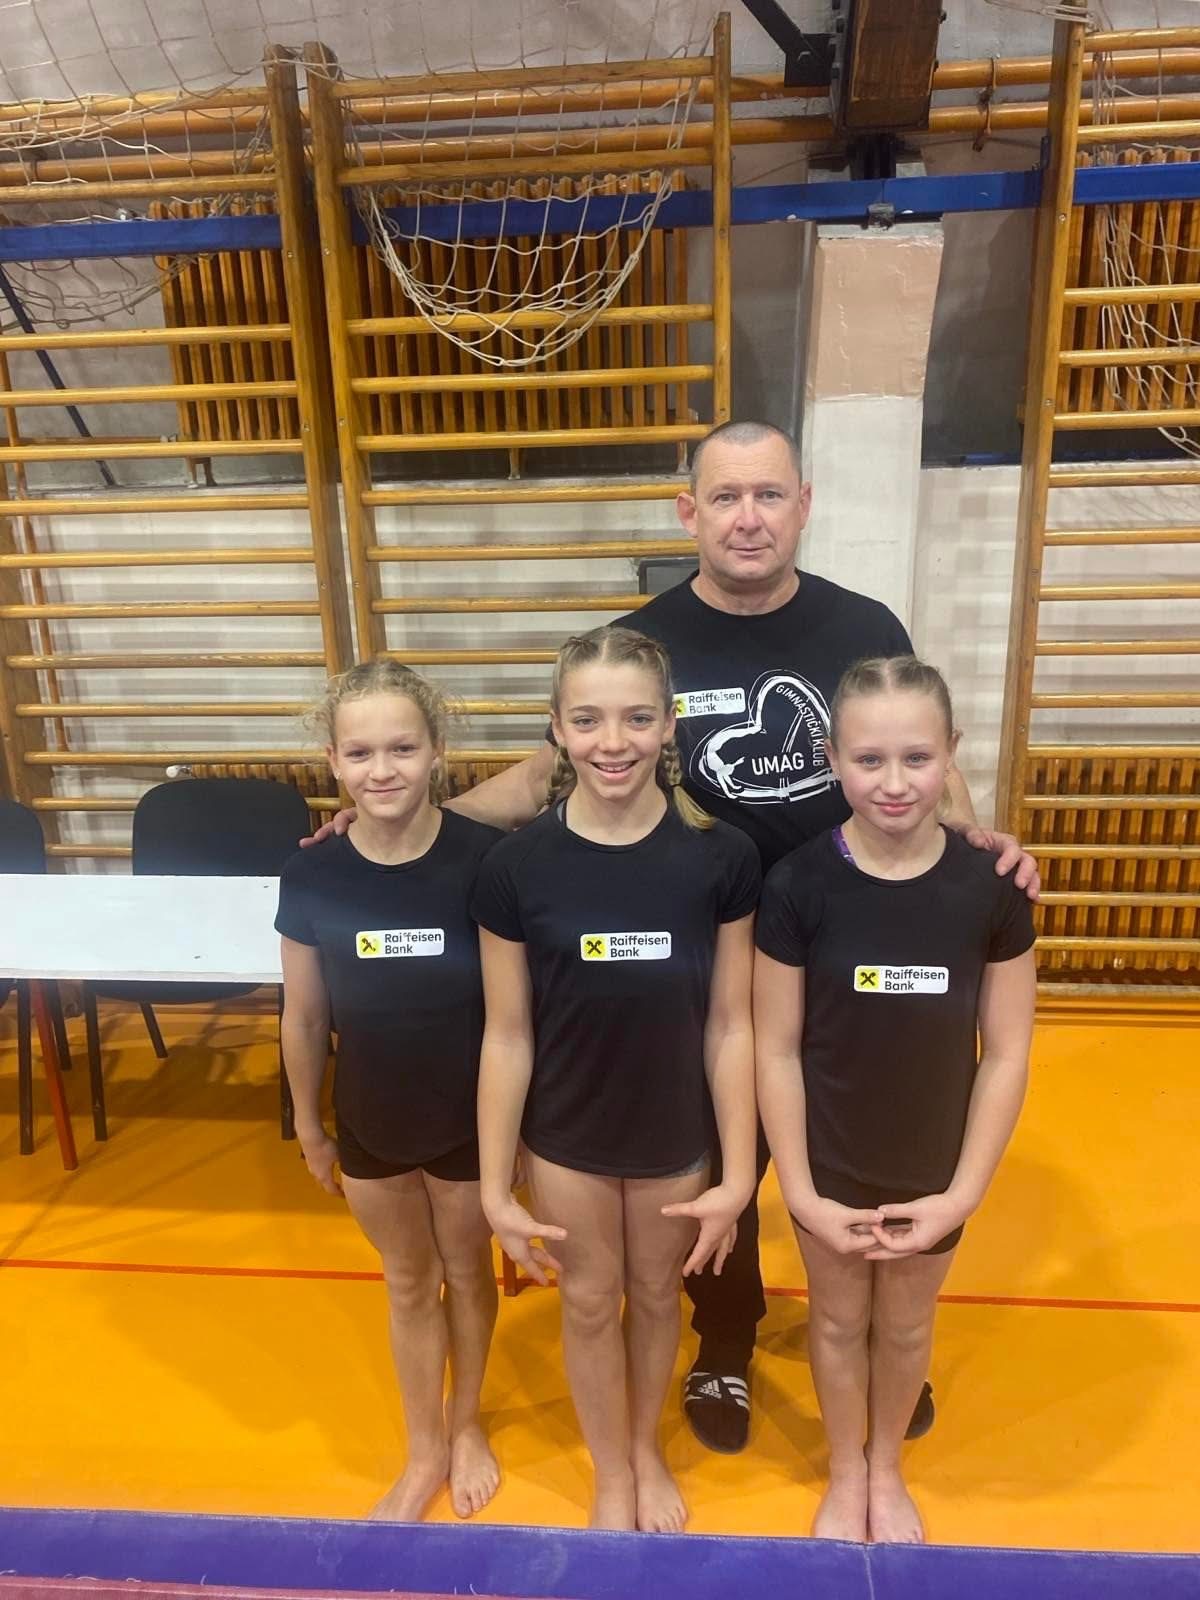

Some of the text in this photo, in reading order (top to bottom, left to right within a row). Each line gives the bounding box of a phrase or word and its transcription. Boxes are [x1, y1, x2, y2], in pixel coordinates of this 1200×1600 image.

[689, 703, 717, 714] Bank
[812, 738, 825, 767] KLUB
[751, 752, 805, 776] UMAG
[609, 935, 669, 947] Raiffeisen
[384, 944, 414, 955] Bank
[610, 947, 640, 958] Bank
[884, 969, 946, 980] Raiffeisen
[884, 981, 915, 991] Bank
